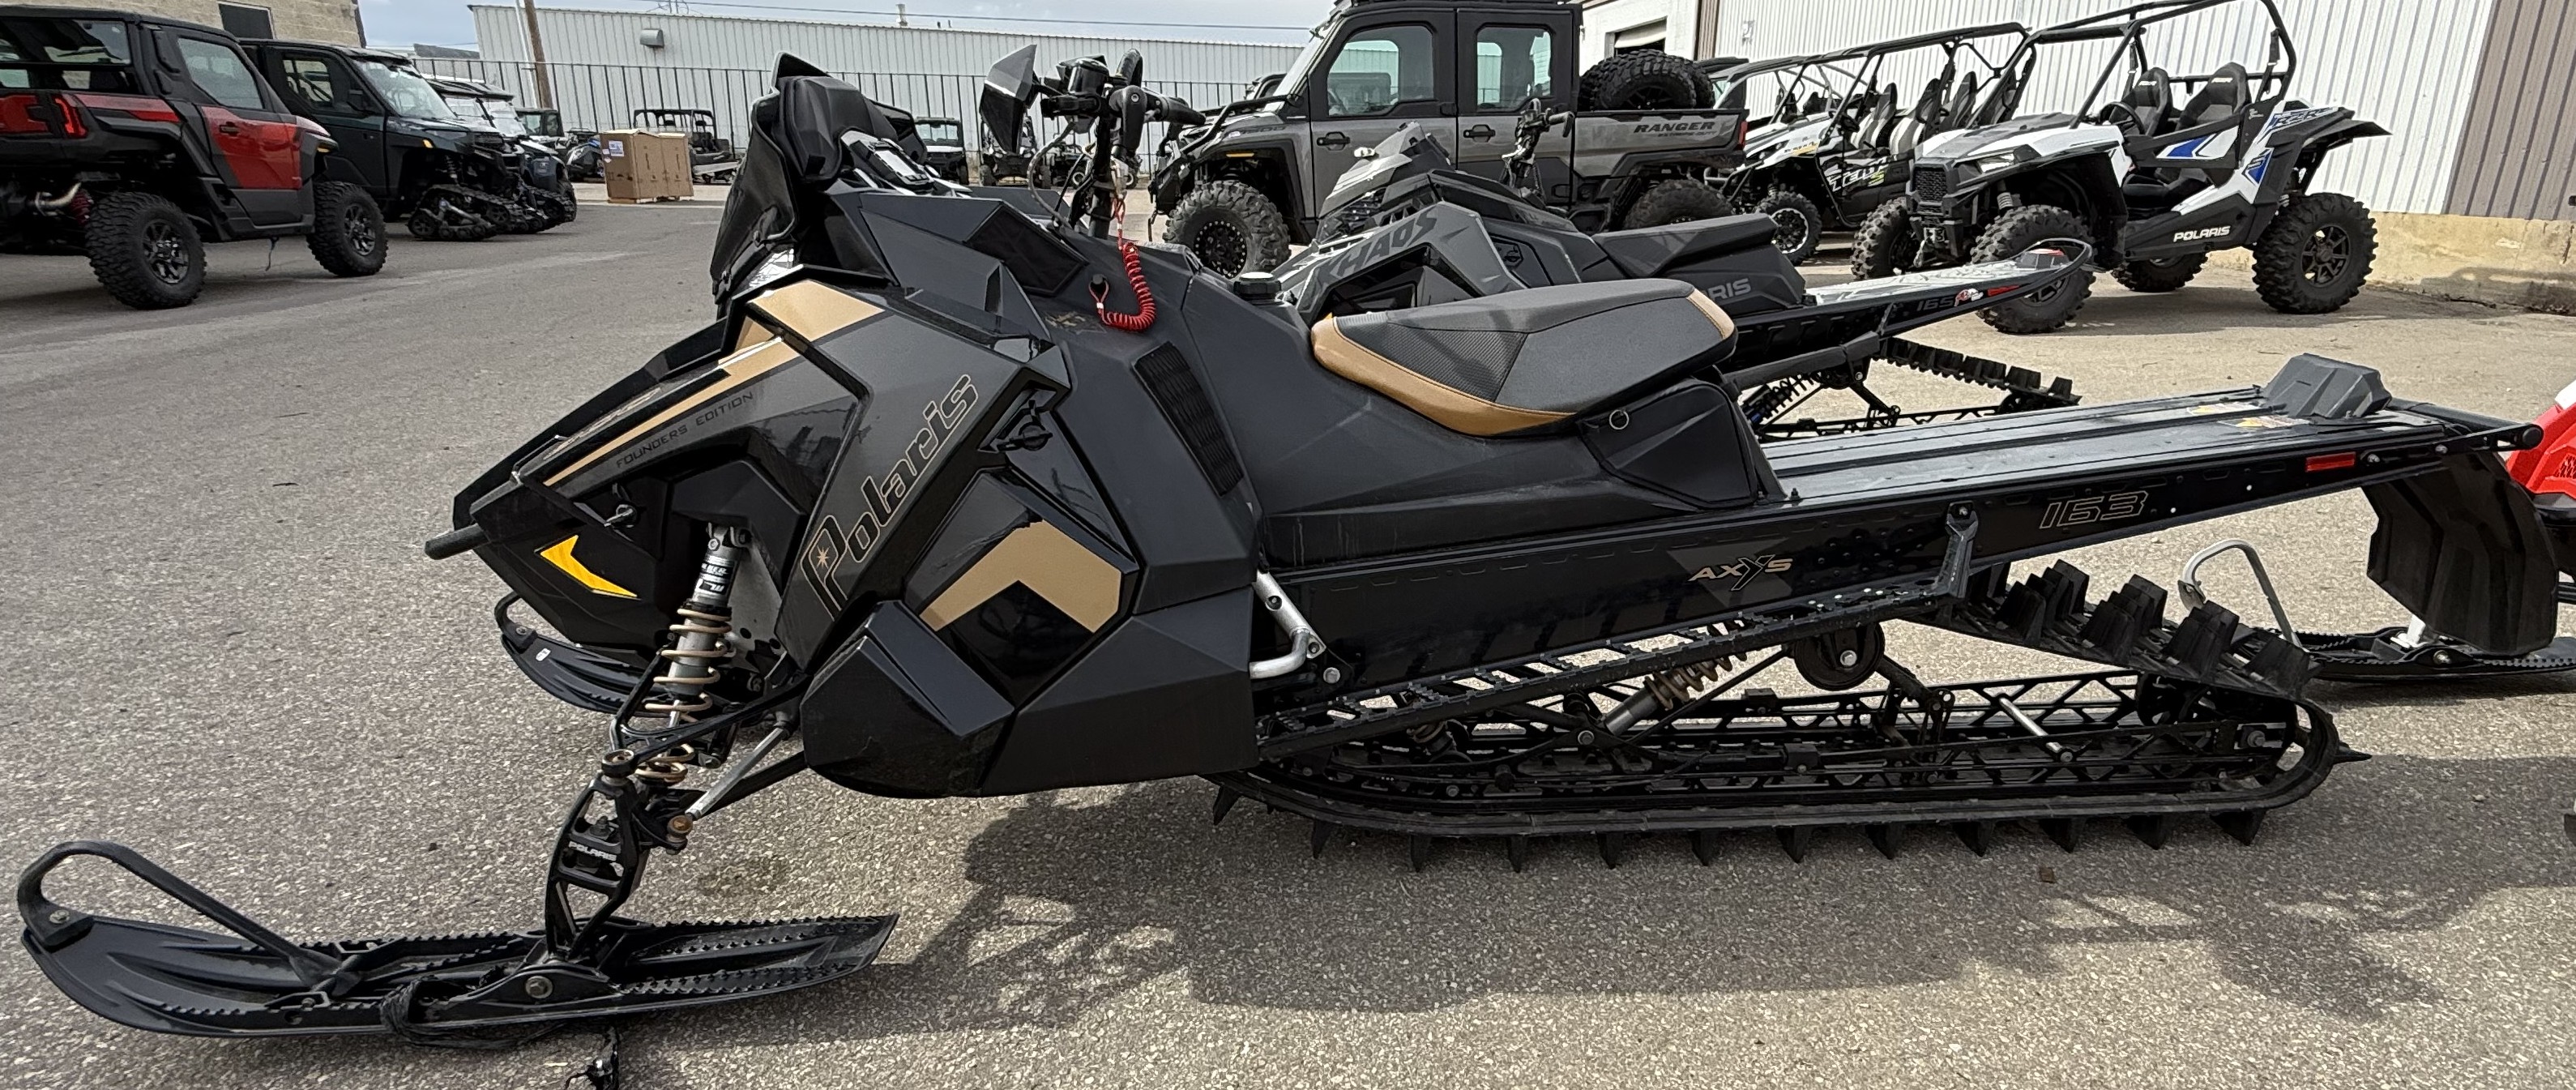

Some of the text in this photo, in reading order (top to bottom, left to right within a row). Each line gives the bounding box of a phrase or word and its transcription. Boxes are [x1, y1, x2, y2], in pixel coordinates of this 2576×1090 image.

[1634, 122, 1715, 133] RANGER
[1316, 205, 1438, 280] KHAOS
[2172, 225, 2231, 242] POLARIS
[616, 425, 688, 468] FOUNDERS
[695, 391, 754, 426] EDITION
[801, 374, 979, 622] Polaris
[2039, 490, 2149, 528] 163
[1687, 554, 1793, 591] AXYS
[568, 840, 617, 861] POLARIS
